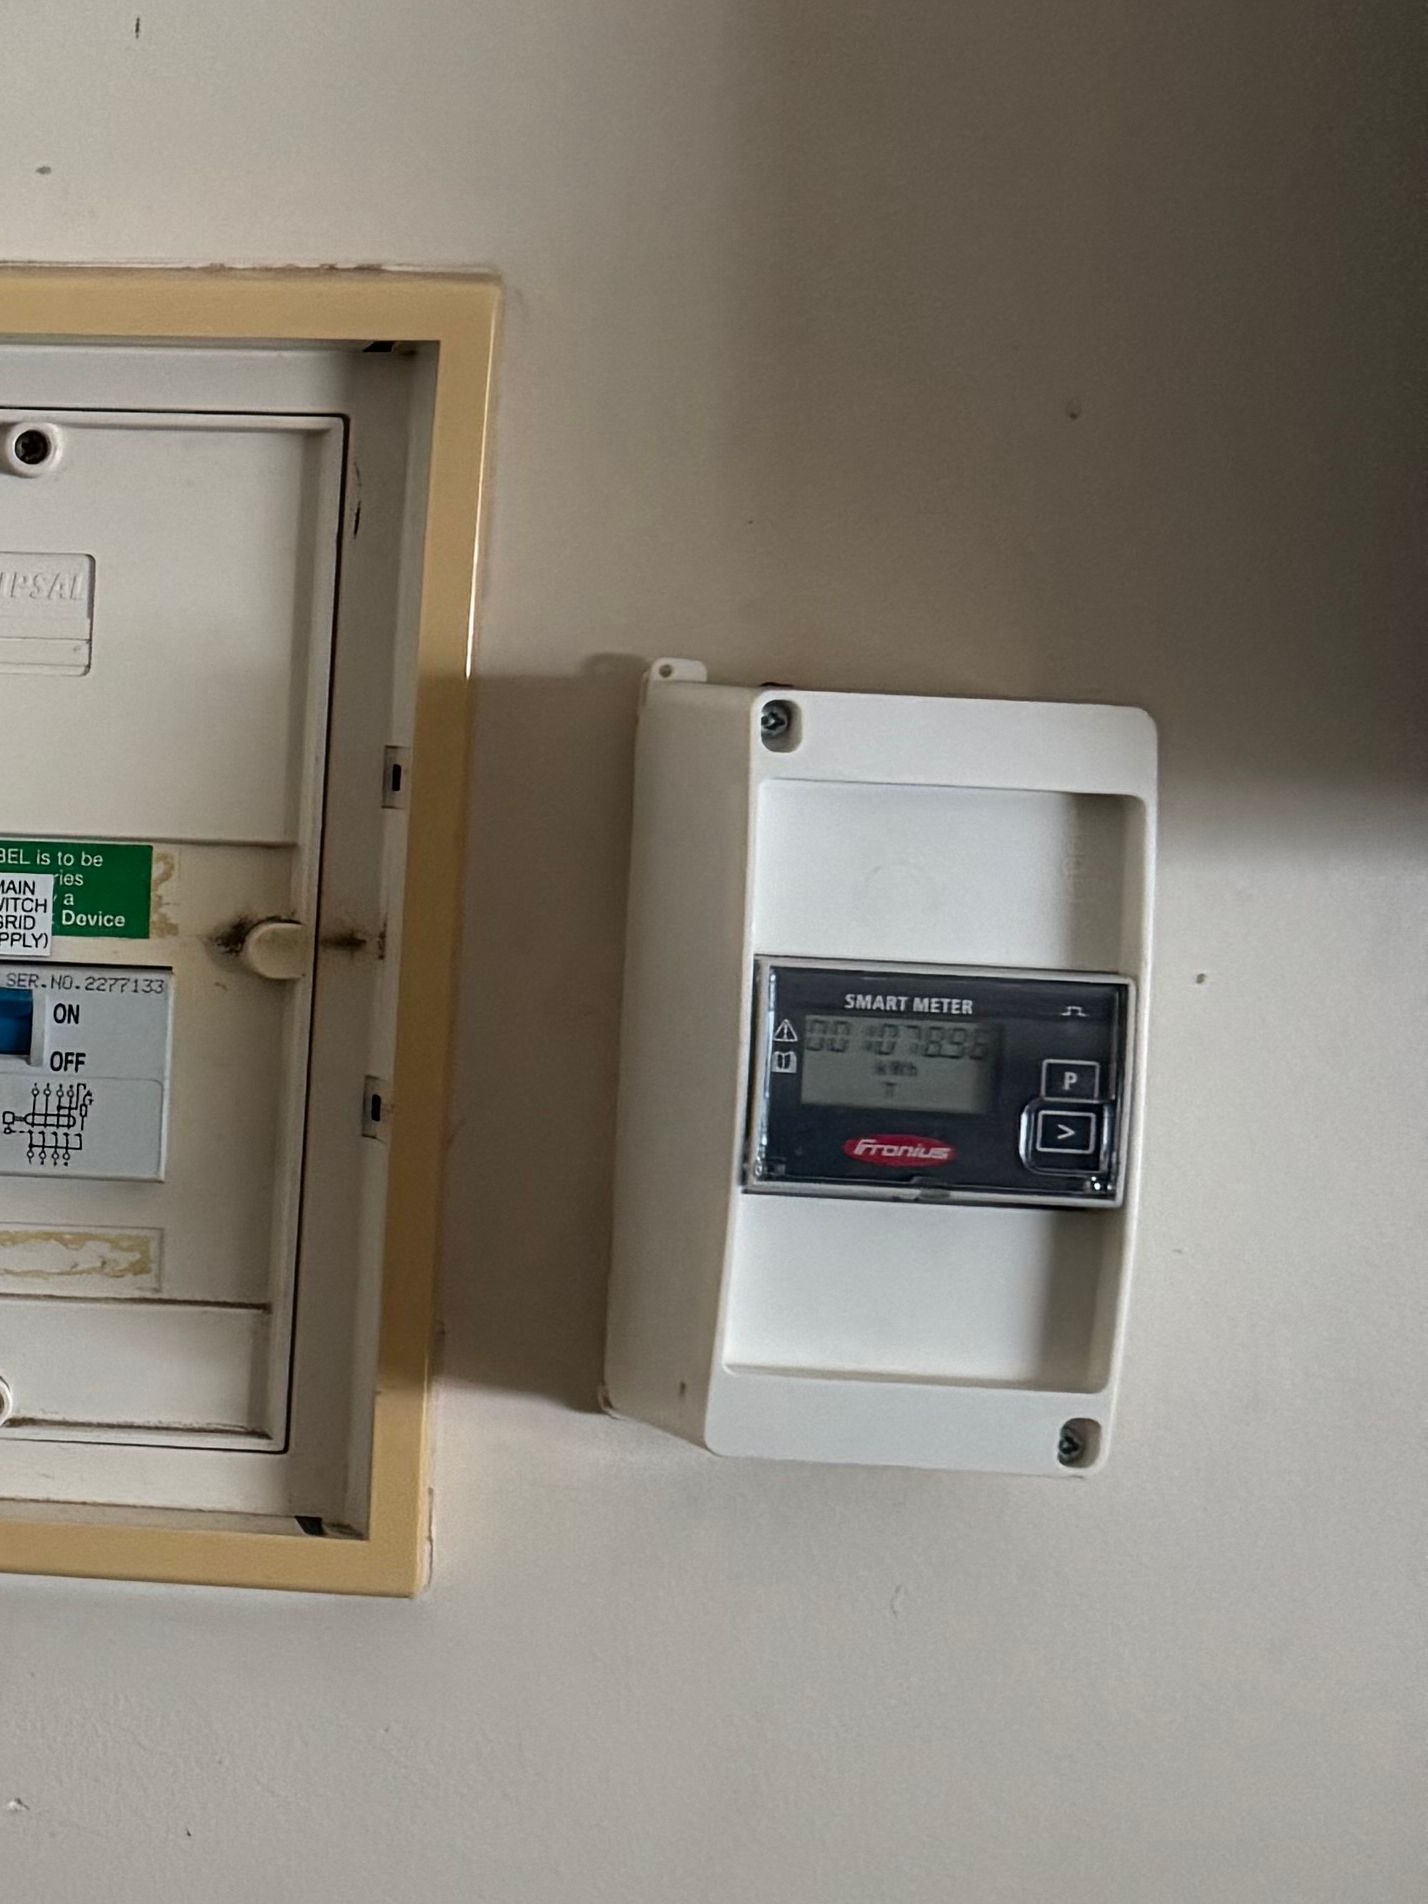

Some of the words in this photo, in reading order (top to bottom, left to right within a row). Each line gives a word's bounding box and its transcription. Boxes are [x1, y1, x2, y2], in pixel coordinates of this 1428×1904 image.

[36, 849, 51, 865] is
[58, 851, 75, 867] to
[80, 851, 104, 867] be
[62, 909, 126, 927] Device
[53, 1002, 81, 1025] ON
[844, 993, 908, 1012] SMART
[912, 995, 974, 1015] METER
[49, 1050, 87, 1073] OFF
[1063, 1071, 1078, 1091] P
[853, 1138, 952, 1160] Fronius
